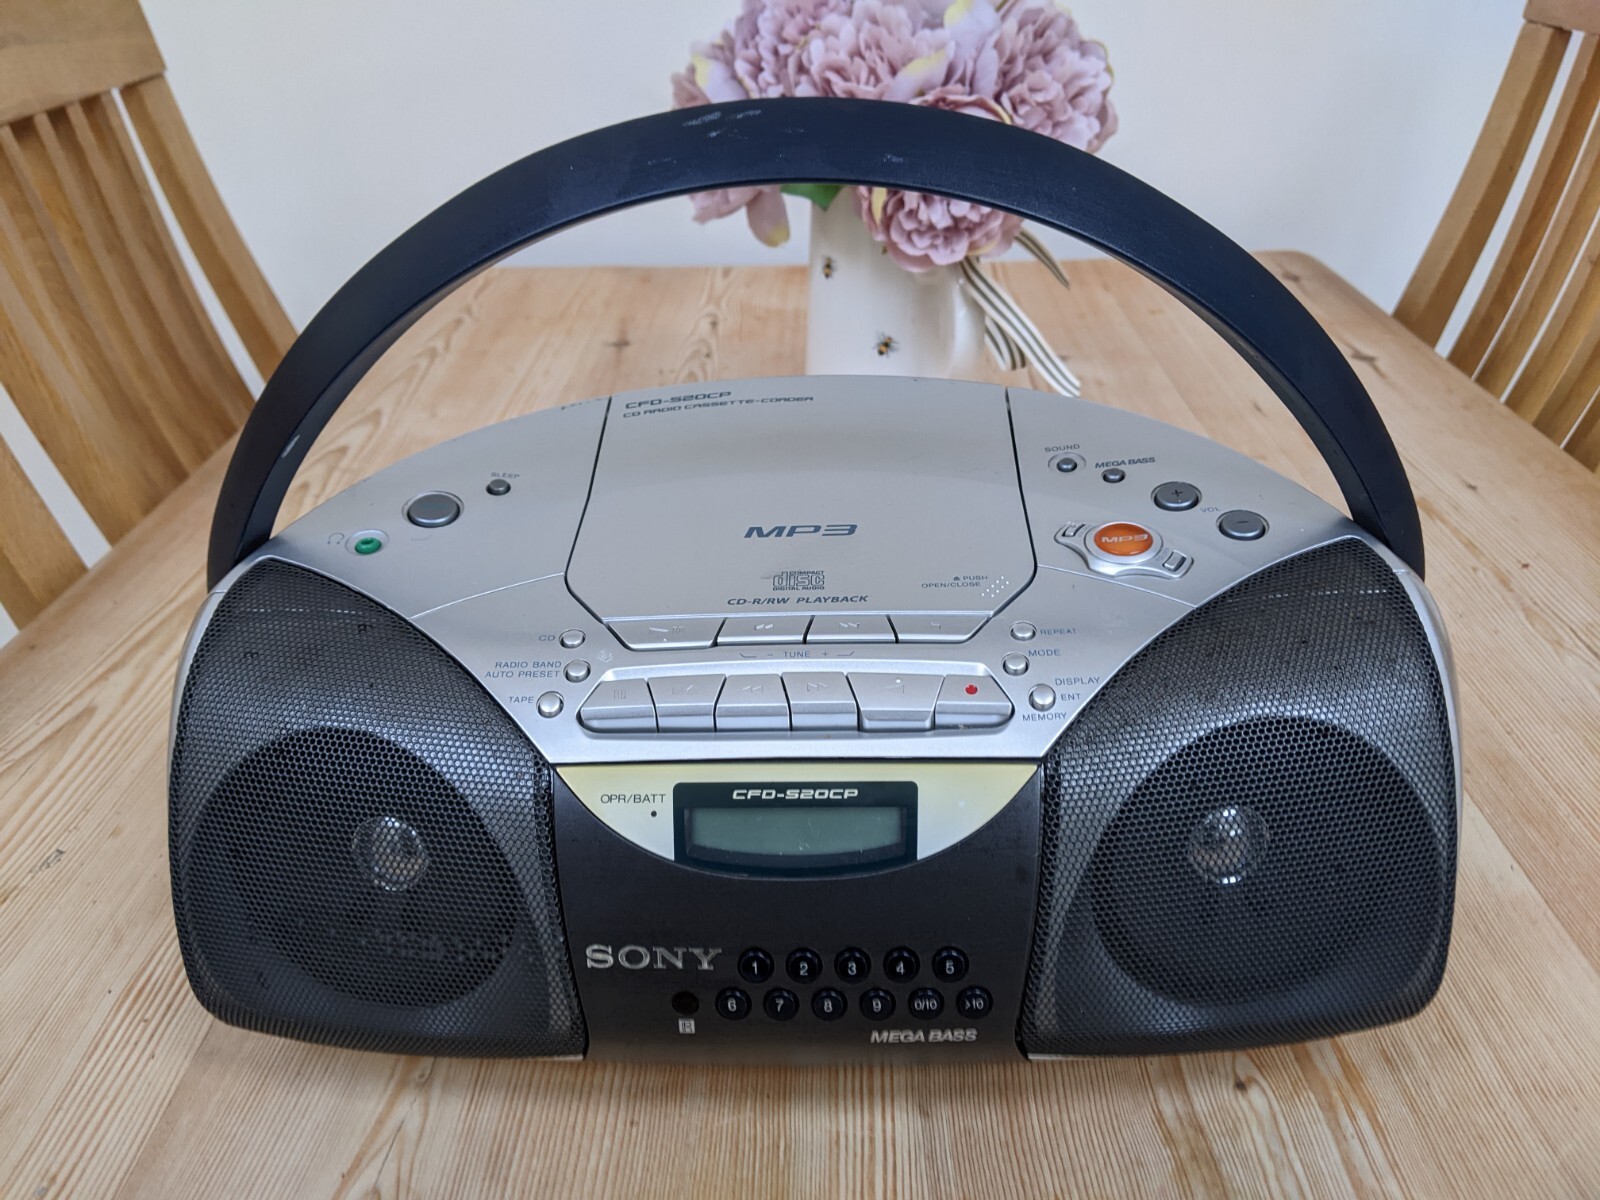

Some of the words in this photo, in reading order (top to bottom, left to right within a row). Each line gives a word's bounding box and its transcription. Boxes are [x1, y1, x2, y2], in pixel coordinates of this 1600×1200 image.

[625, 391, 731, 409] CFD-S20CP
[643, 405, 681, 415] RADIO
[1044, 443, 1081, 453] SOUND
[1095, 460, 1127, 469] MEGA
[1128, 456, 1156, 466] BASS
[743, 524, 858, 539] MP3
[1101, 532, 1148, 543] MP3
[921, 581, 981, 589] OPEN/CLOSE
[727, 596, 790, 606] CD-R/RW
[796, 595, 869, 605] PLAYBACK
[1040, 627, 1077, 636] REPEAT
[538, 634, 556, 642] CD
[1028, 649, 1061, 657] MODE
[495, 661, 528, 669] RADIO
[532, 661, 562, 669] BAND
[485, 671, 515, 679] AUTO
[518, 670, 561, 678] PRESET
[1055, 676, 1101, 687] DISPLAY
[508, 696, 535, 704] TAPE
[1060, 693, 1081, 701] ENT
[1022, 712, 1068, 723] MEMORY
[600, 793, 667, 804] OPR/BATT
[732, 788, 858, 800] CFD-S20CP
[585, 944, 722, 971] SONY
[751, 961, 759, 975] 1
[799, 961, 809, 976] 2
[847, 961, 857, 975] 3
[896, 961, 905, 975] 4
[945, 961, 955, 975] 5
[727, 999, 737, 1012] 6
[775, 999, 784, 1012] 7
[823, 1000, 834, 1013] 8
[872, 999, 882, 1013] 9
[914, 998, 937, 1011] 0/10
[870, 1029, 925, 1044] MEGA
[928, 1028, 978, 1043] BASS
